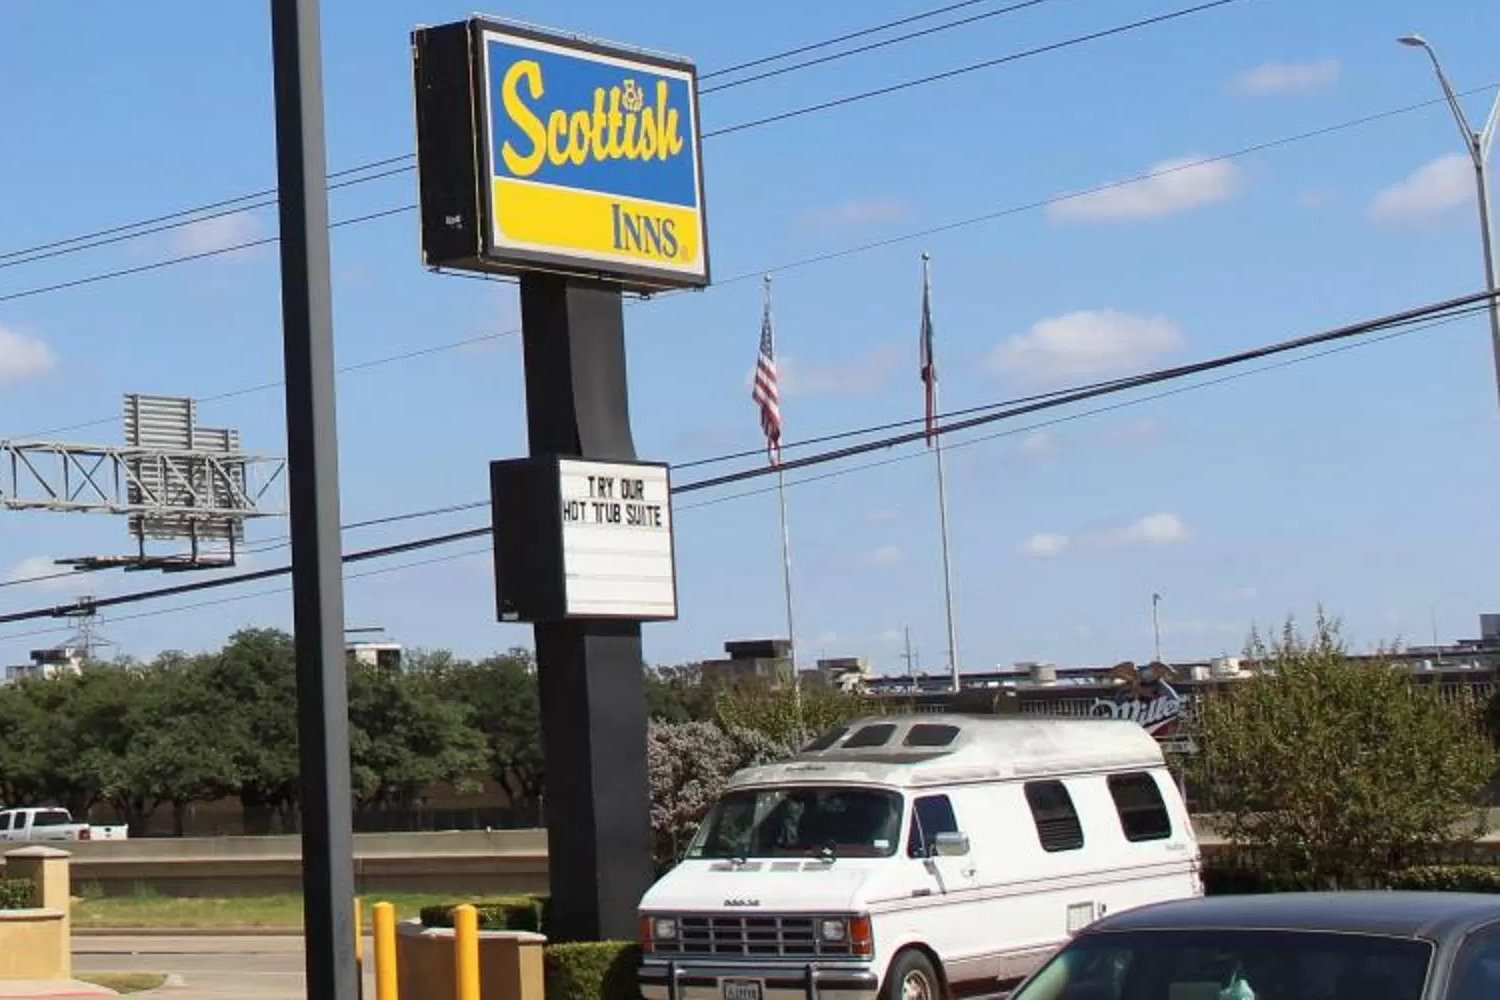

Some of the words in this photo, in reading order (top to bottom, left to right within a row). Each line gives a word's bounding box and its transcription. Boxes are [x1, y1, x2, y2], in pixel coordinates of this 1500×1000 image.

[502, 60, 682, 176] Scottish
[612, 204, 678, 258] INNS
[587, 476, 614, 498] TRY
[621, 478, 644, 500] OUR
[563, 500, 587, 521] HOT
[626, 504, 661, 527] SUITE
